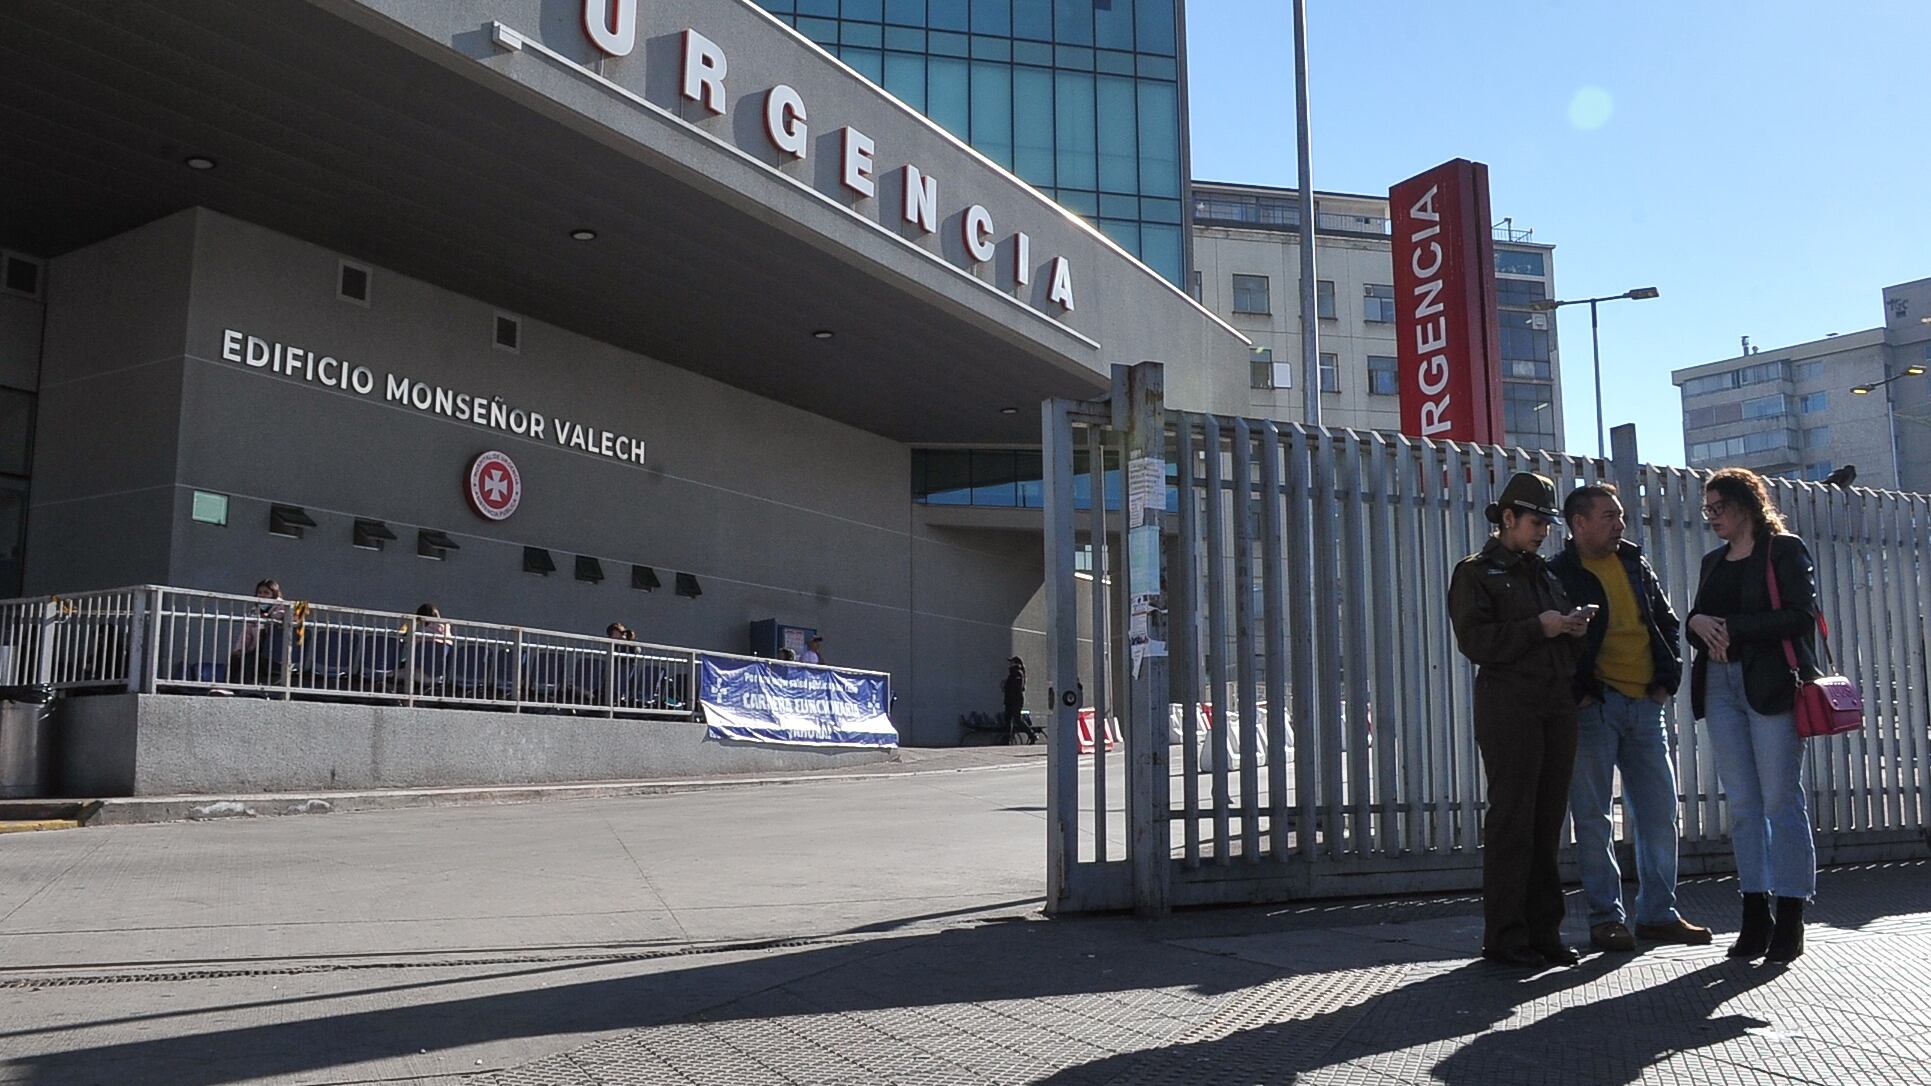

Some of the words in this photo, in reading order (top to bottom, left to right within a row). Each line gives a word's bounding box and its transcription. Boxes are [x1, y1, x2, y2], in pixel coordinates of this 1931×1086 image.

[582, 0, 1075, 311] URGENCIA
[222, 329, 374, 394] EDIFICIO
[386, 373, 545, 440] MONSEÑOR
[554, 418, 646, 465] VALECH
[1410, 183, 1453, 437] RGENCIA
